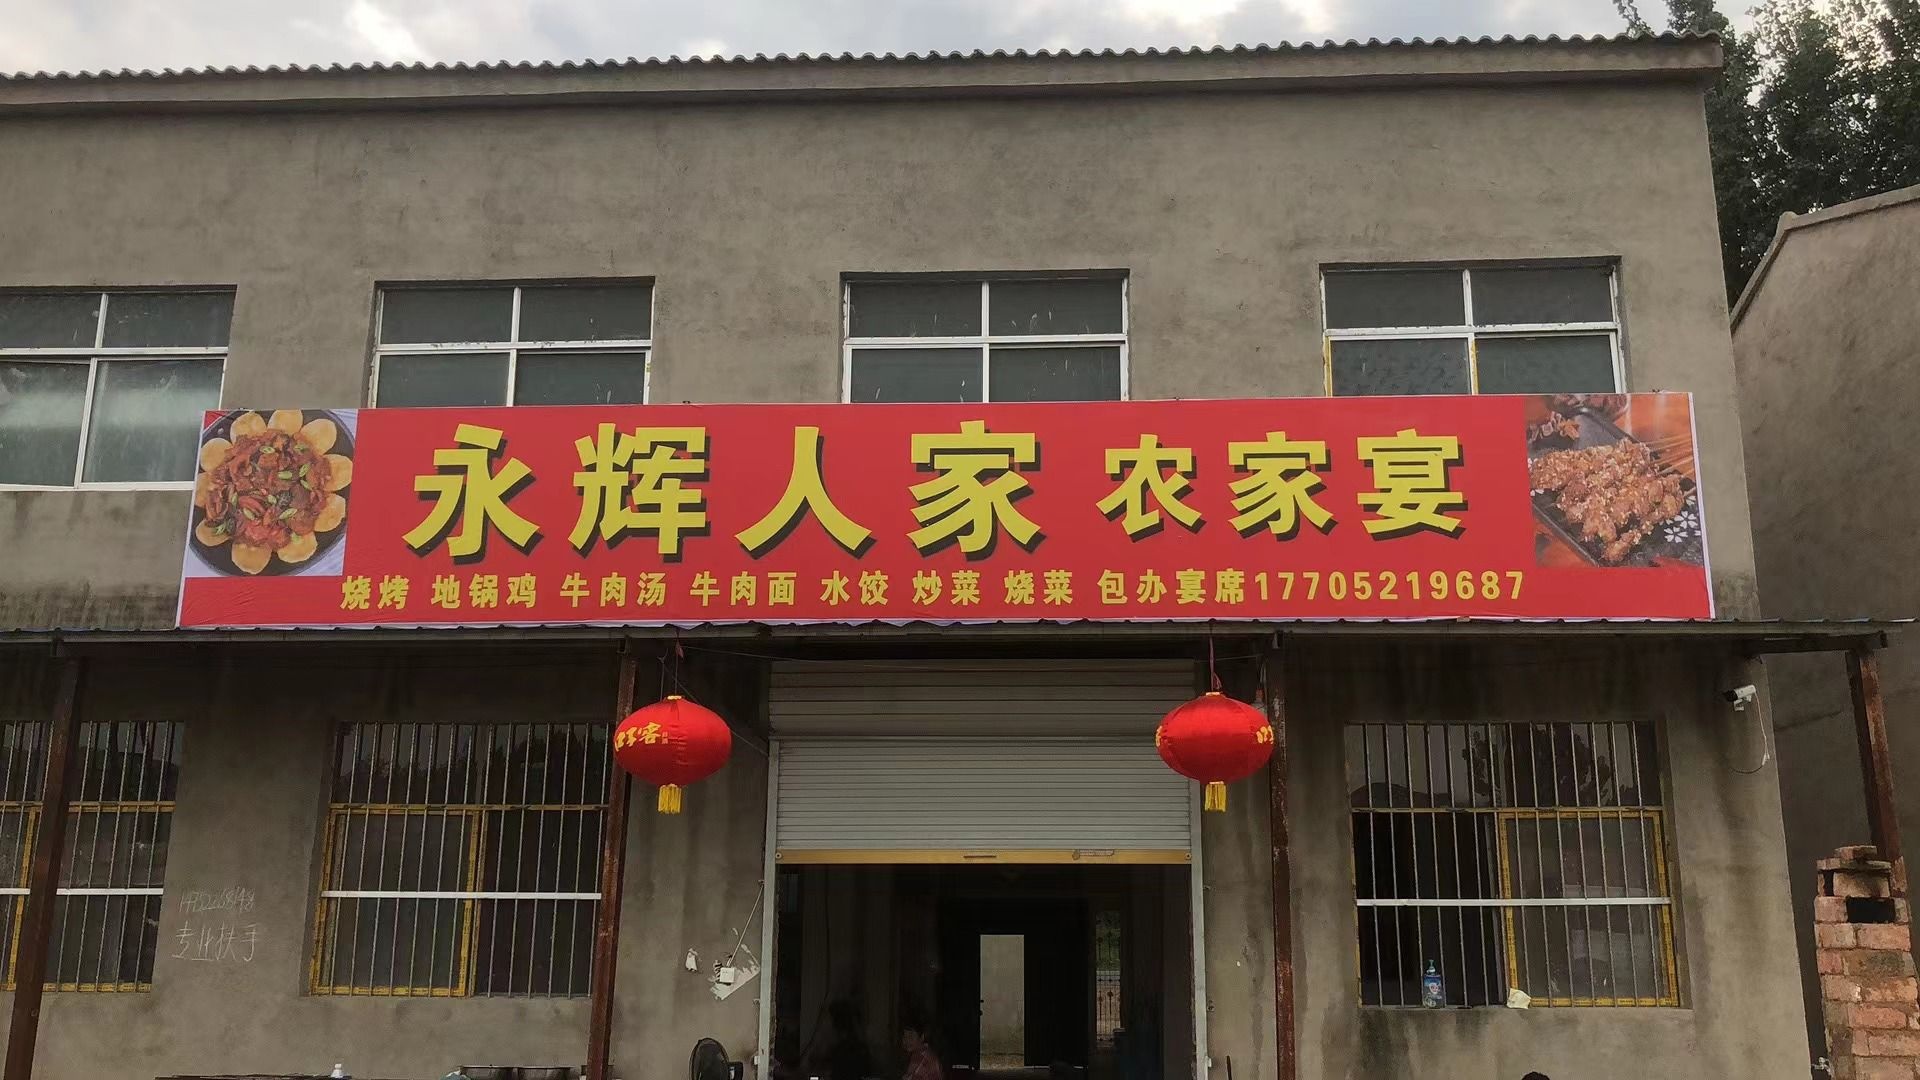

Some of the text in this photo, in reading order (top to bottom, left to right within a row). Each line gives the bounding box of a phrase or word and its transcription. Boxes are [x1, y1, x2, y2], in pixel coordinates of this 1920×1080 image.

[403, 423, 1464, 558] 永辉人家 农家宴
[340, 574, 409, 609] 烧烤
[431, 573, 536, 608] 地锅鸡
[560, 572, 665, 607] 牛肉汤
[690, 571, 796, 606] 牛肉面
[820, 570, 888, 605] 水饺
[913, 570, 980, 605] 炒菜
[1004, 570, 1072, 605] 烧菜
